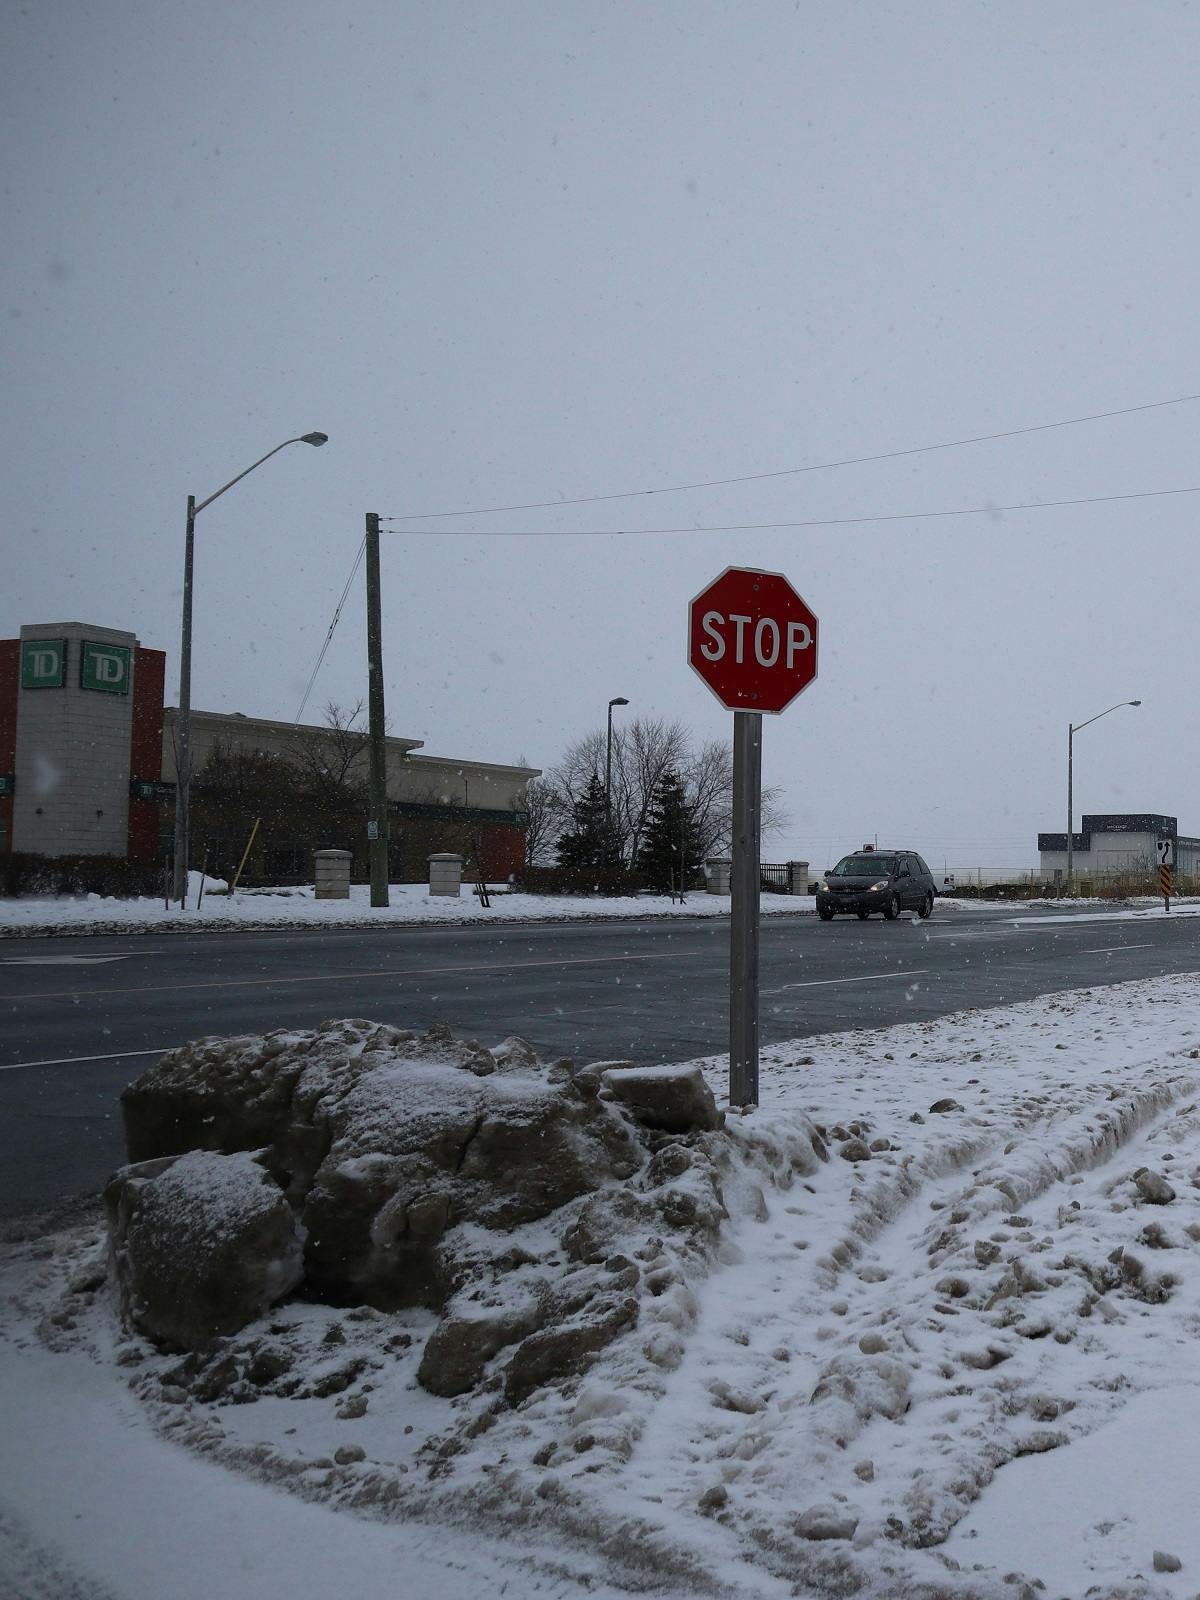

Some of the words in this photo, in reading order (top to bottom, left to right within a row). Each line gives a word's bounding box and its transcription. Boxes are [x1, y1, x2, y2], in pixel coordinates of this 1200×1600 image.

[700, 610, 812, 669] STOP
[27, 649, 59, 678] TD
[89, 652, 125, 683] TD
